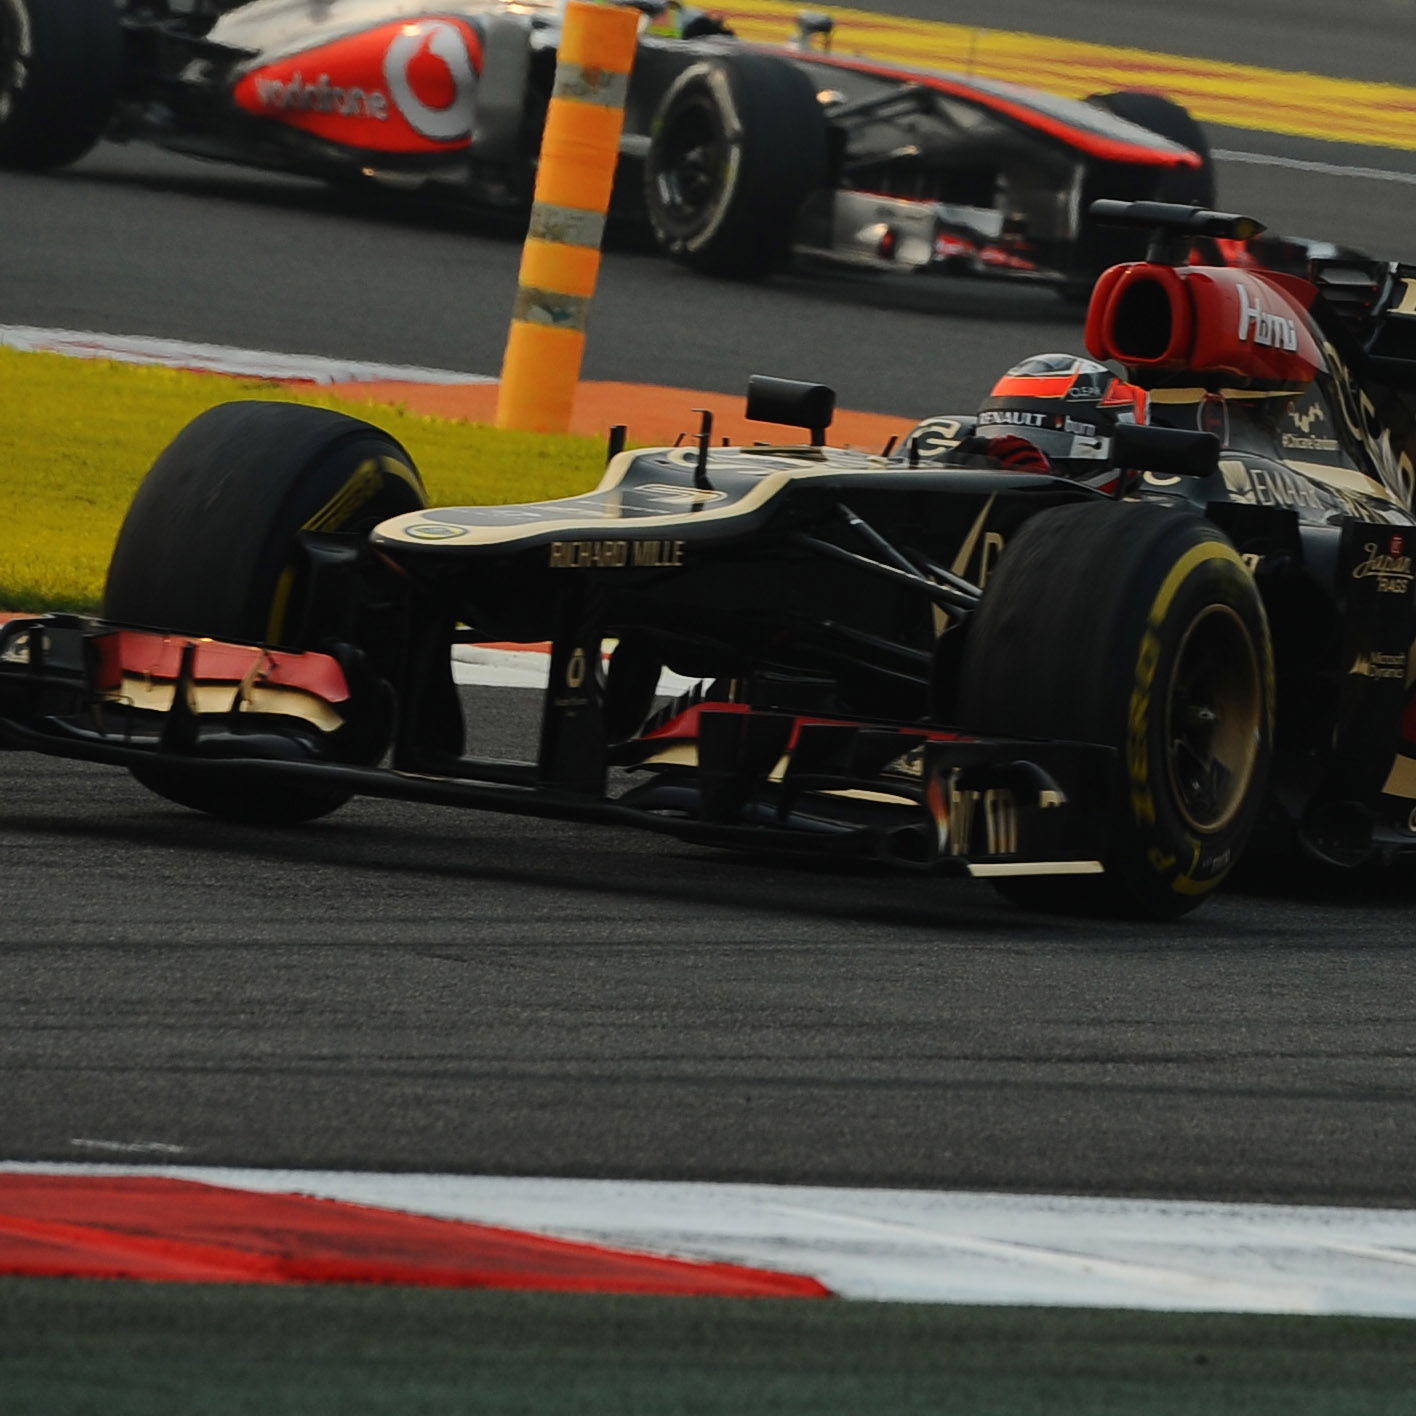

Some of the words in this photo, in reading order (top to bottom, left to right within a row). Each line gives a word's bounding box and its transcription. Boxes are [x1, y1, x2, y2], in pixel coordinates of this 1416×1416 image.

[979, 411, 1047, 427] RENAULT
[549, 541, 628, 568] RICHARD
[632, 540, 686, 567] MILLE
